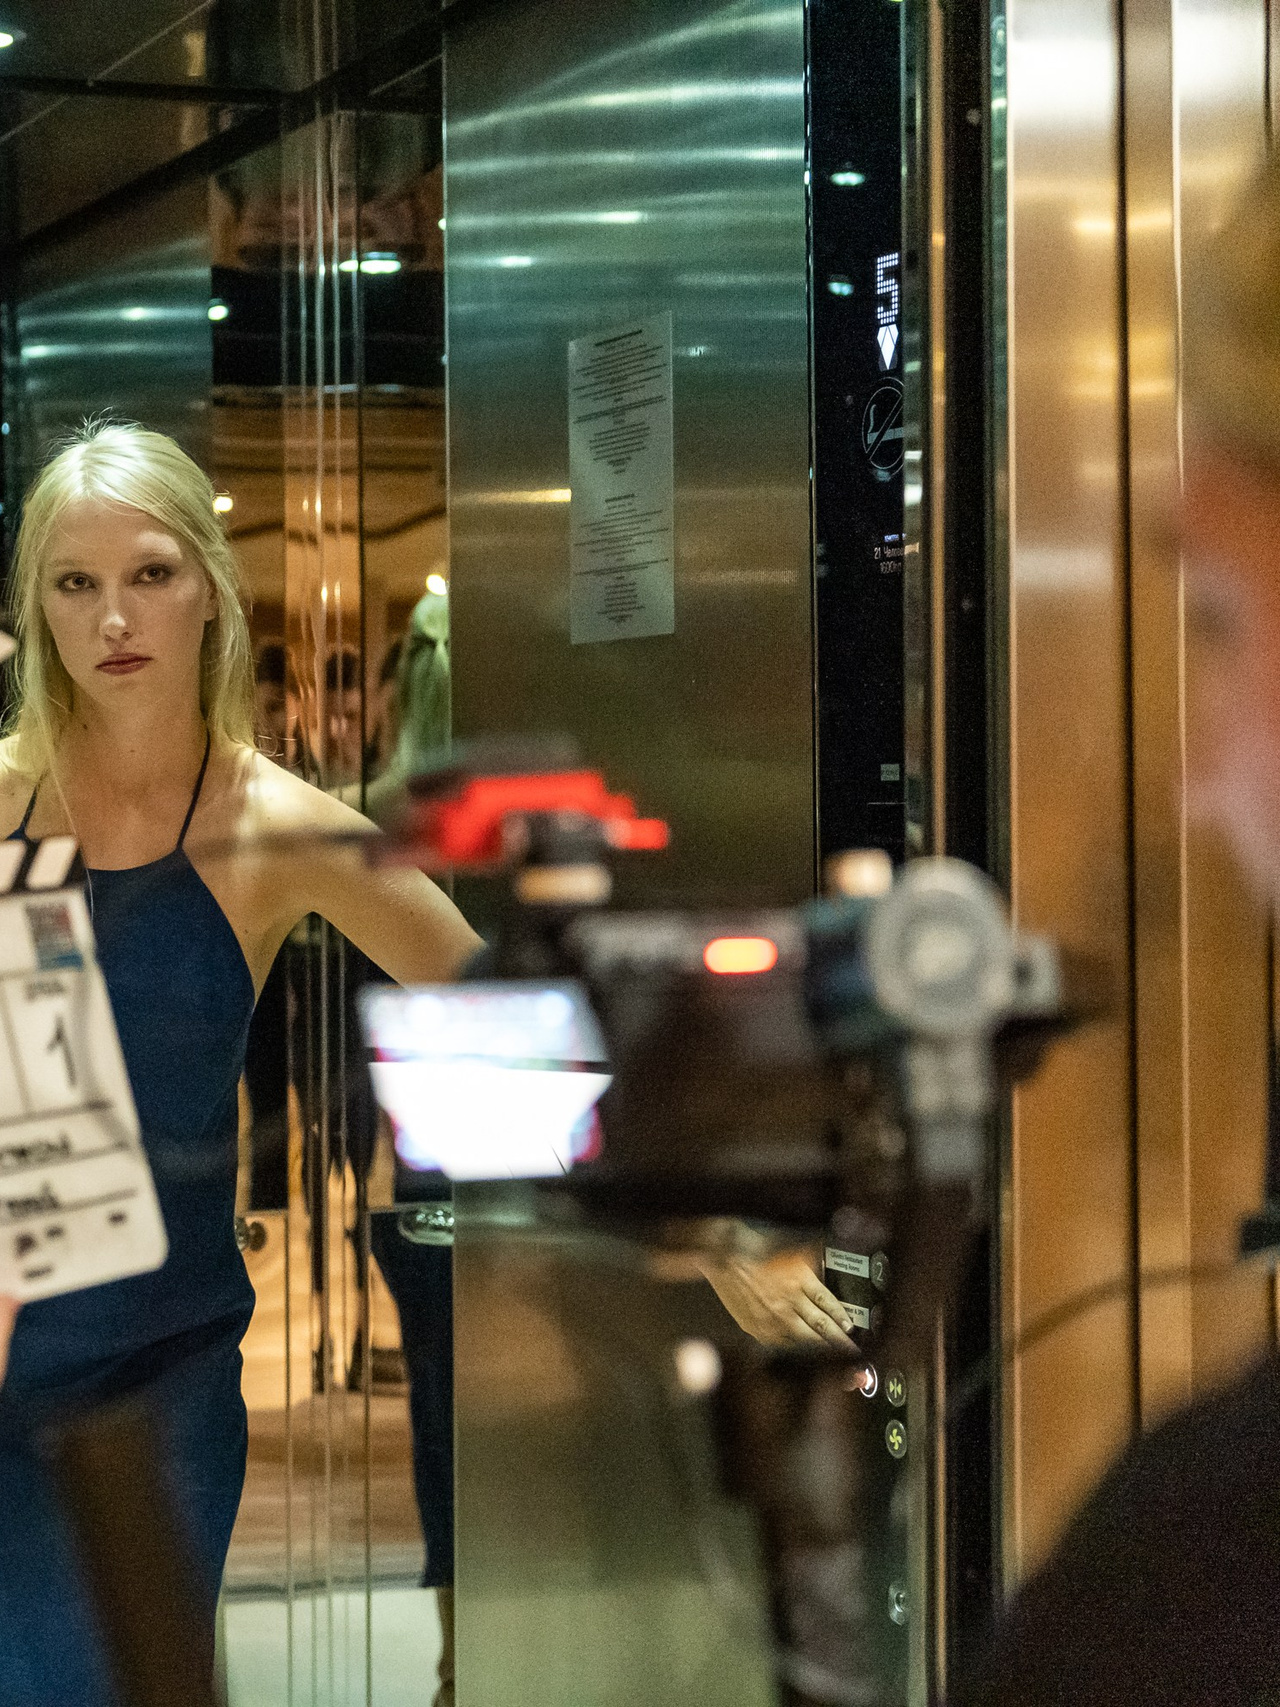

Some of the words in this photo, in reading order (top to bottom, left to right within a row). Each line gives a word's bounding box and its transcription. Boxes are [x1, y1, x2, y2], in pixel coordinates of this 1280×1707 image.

[877, 252, 899, 325] 5
[43, 1012, 78, 1090] 1
[876, 1261, 884, 1281] 2
